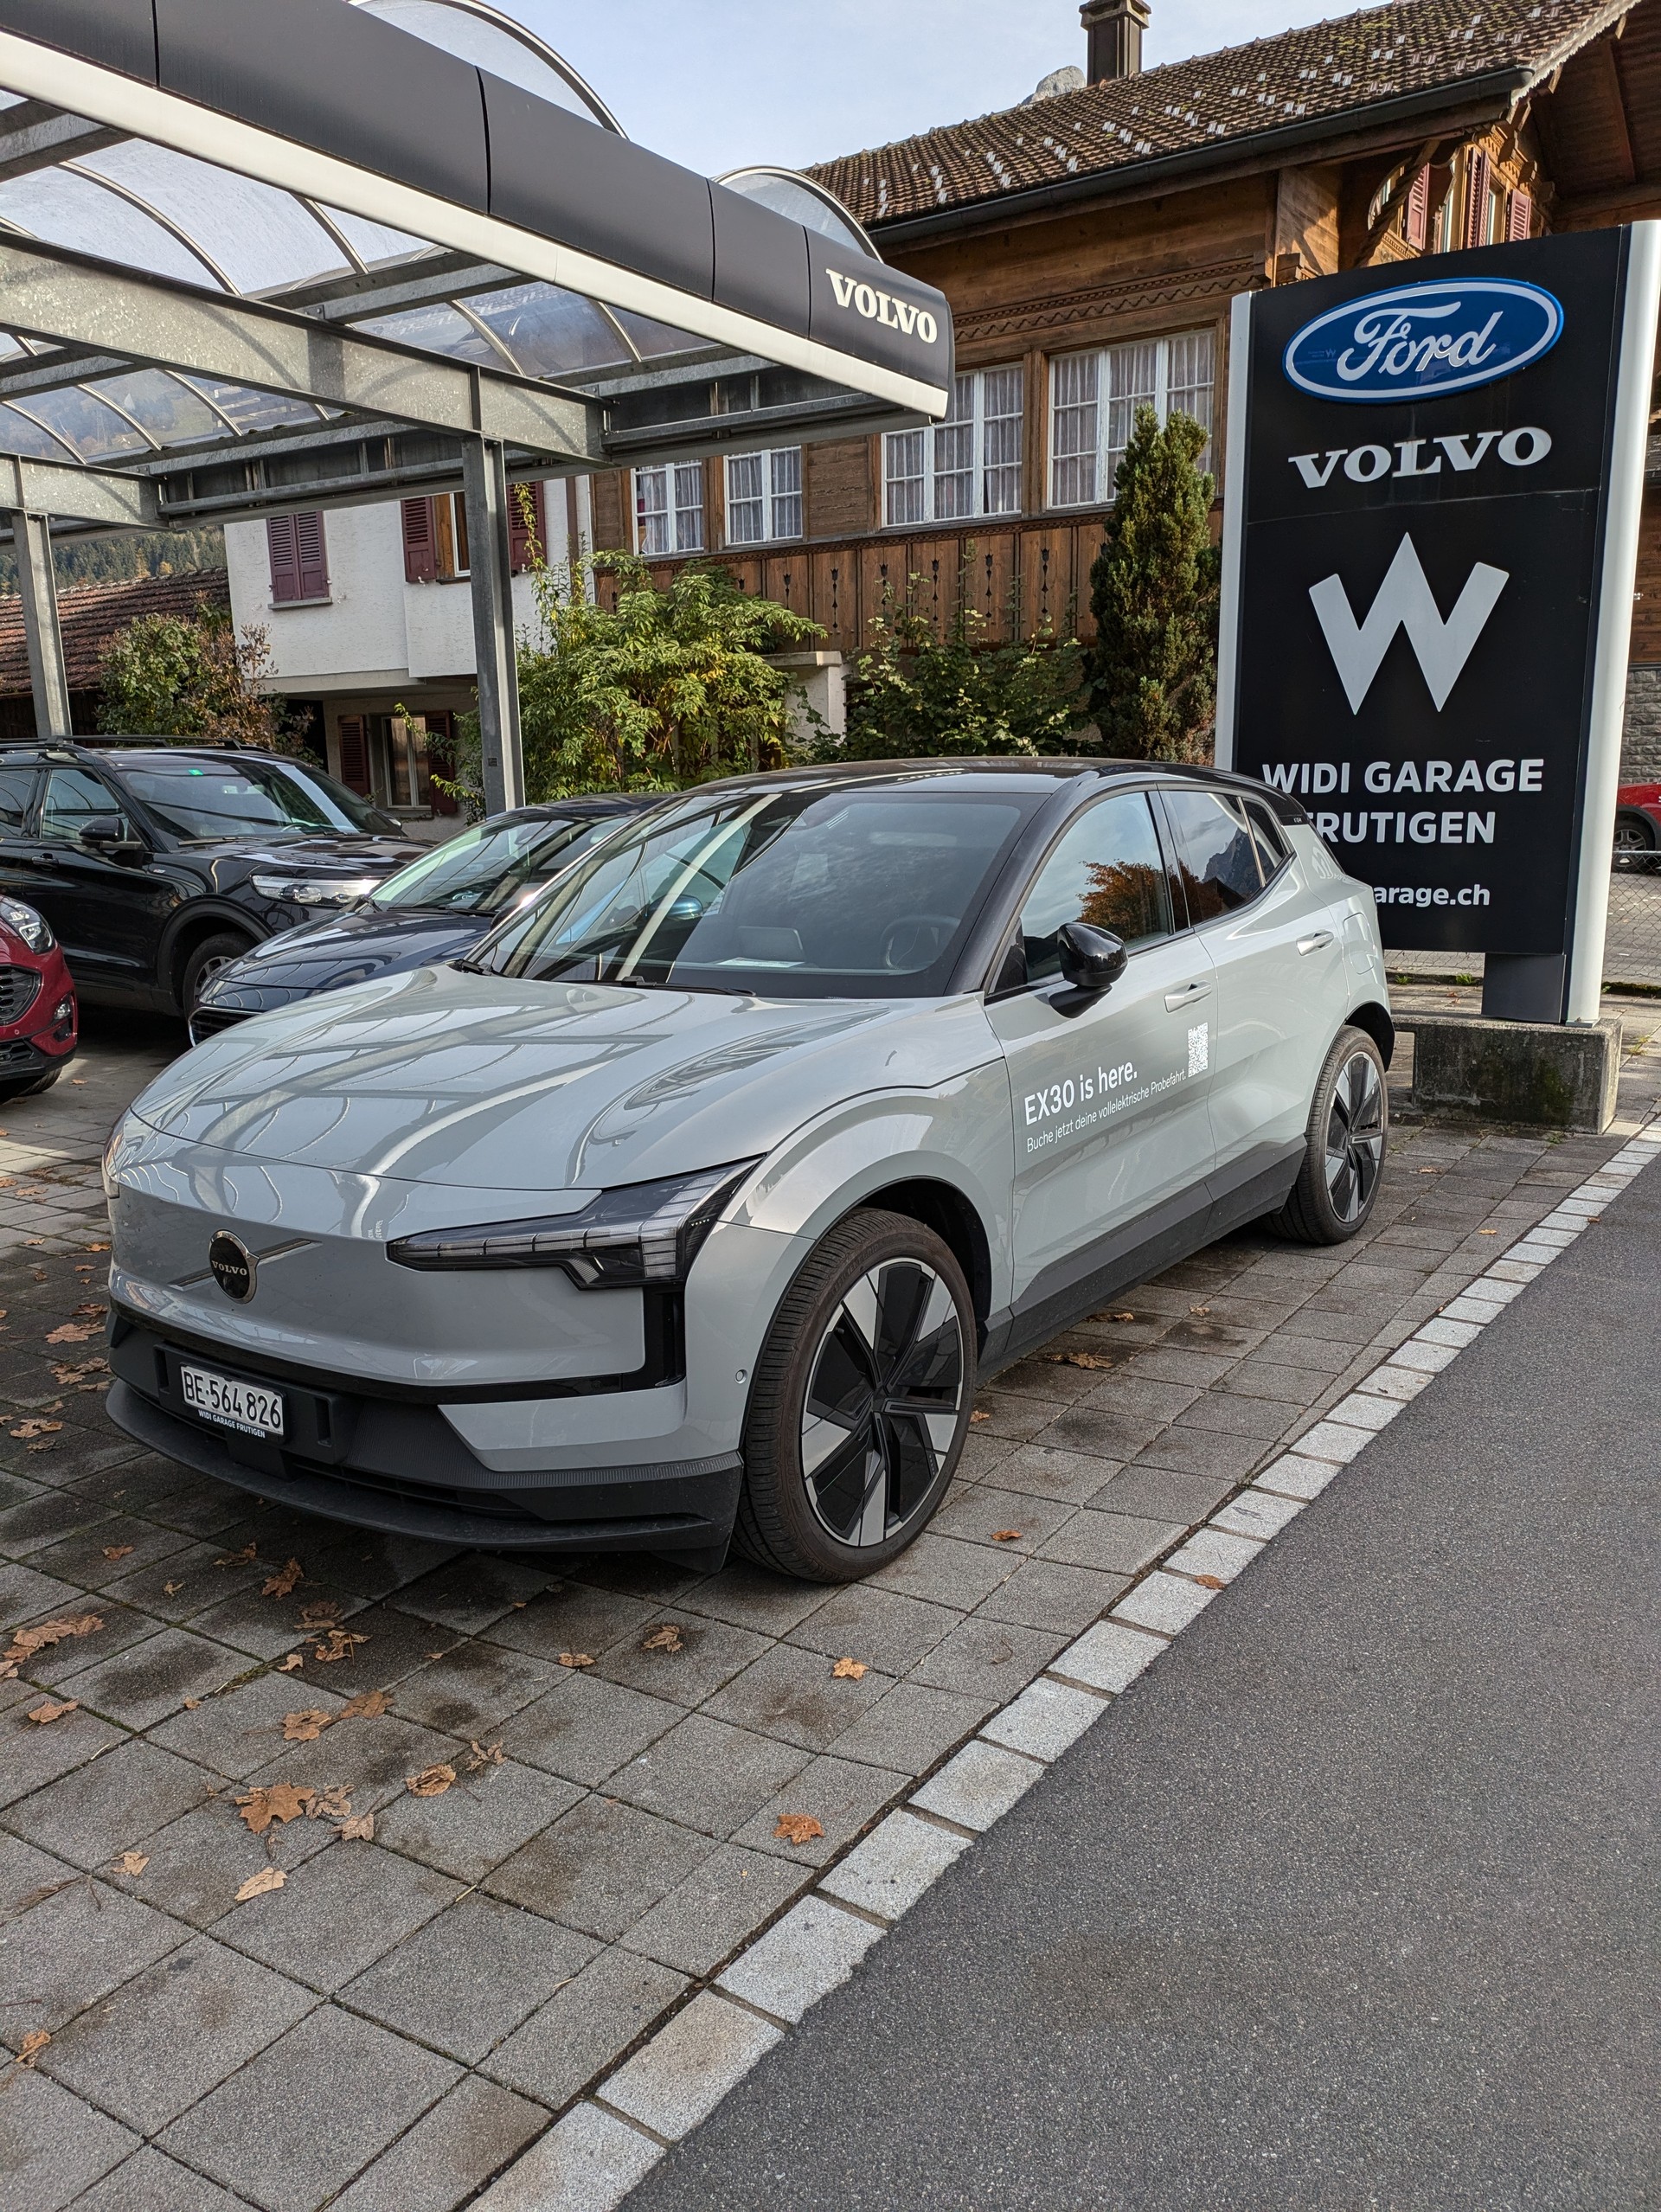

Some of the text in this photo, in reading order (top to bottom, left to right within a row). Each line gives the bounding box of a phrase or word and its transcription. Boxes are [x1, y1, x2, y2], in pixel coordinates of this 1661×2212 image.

[825, 268, 938, 343] VOLVO
[1336, 301, 1504, 381] Ford
[1288, 426, 1552, 489] VOLVO
[1308, 531, 1510, 715] W
[1262, 759, 1544, 793] WIDI GARAGE
[1374, 884, 1490, 907] arage.ch
[1024, 1061, 1138, 1125] EX30 is here.
[1027, 1068, 1187, 1153] Buche jetzt deine vollelektrische Probefahrt.
[211, 1260, 247, 1276] VOLVO
[198, 1409, 266, 1438] WIDI GARAGE FRUTIGEN
